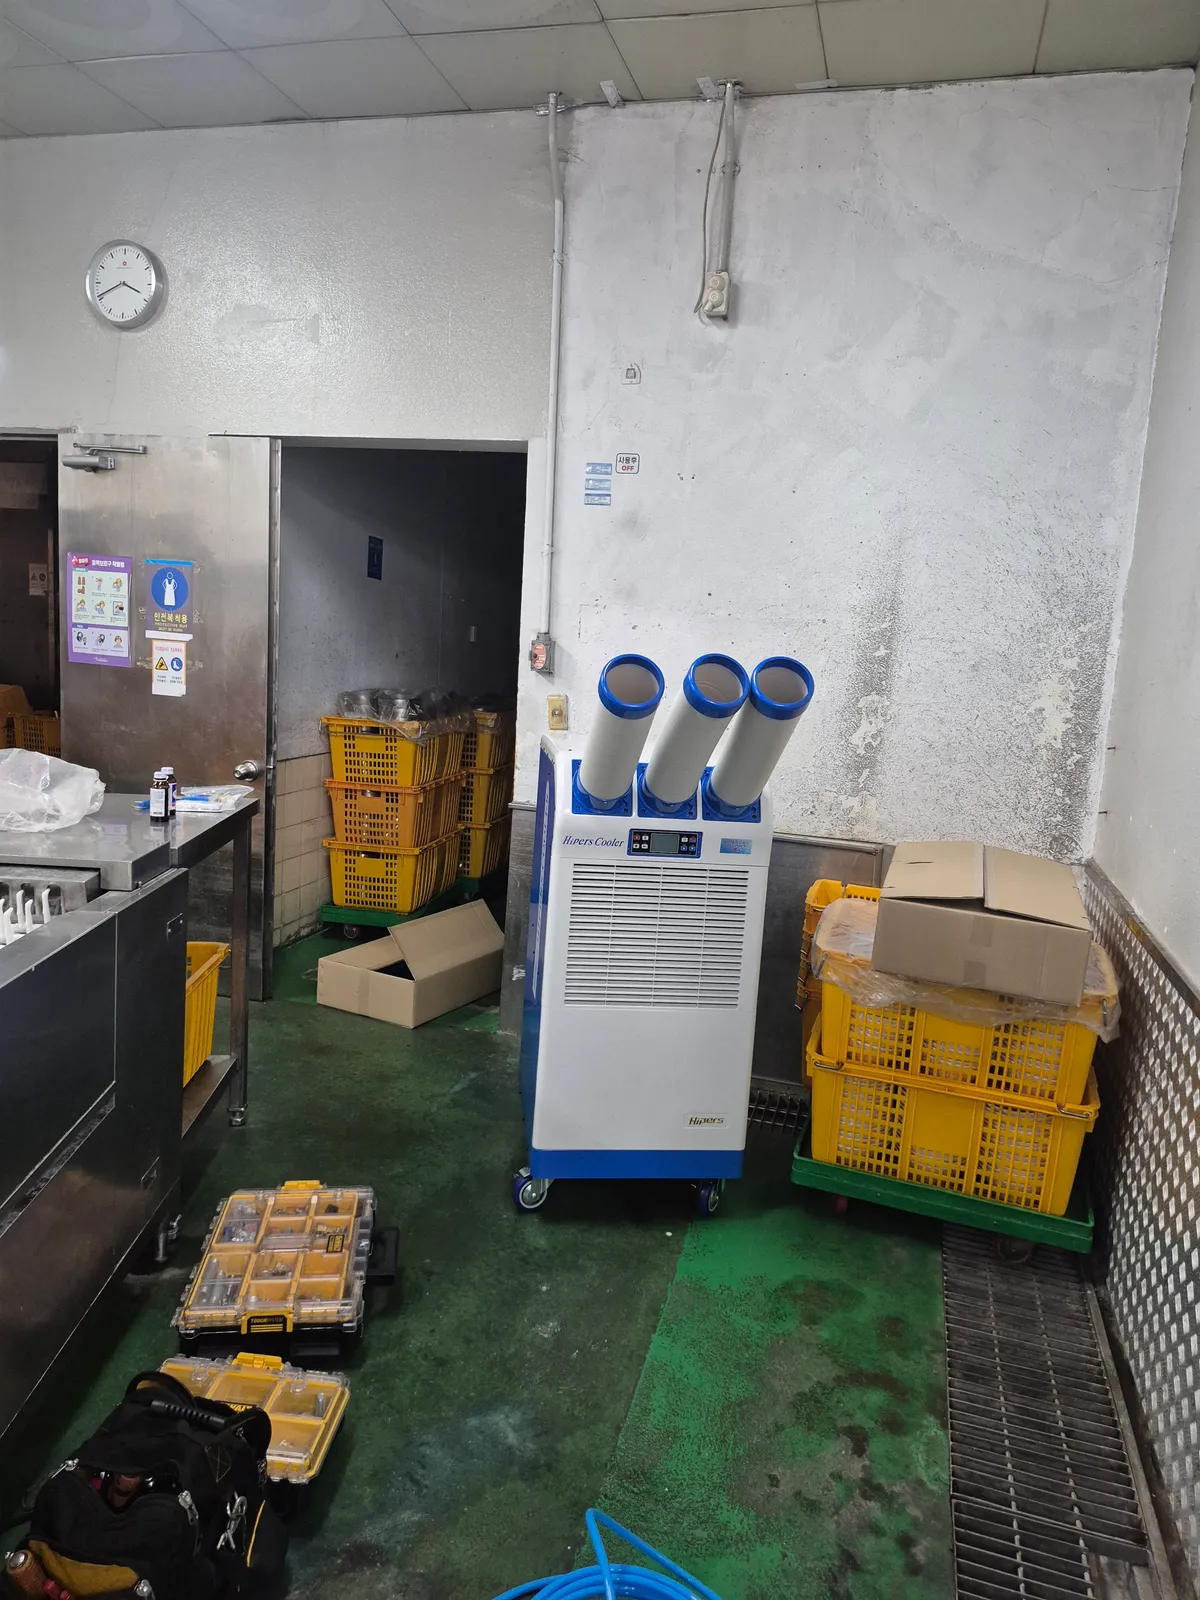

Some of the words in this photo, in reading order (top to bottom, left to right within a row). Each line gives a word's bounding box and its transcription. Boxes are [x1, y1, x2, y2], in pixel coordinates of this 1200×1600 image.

[618, 456, 637, 464] 사용후
[175, 613, 187, 624] 착용
[594, 837, 624, 847] Cooler
[689, 1116, 724, 1125] Hipers
